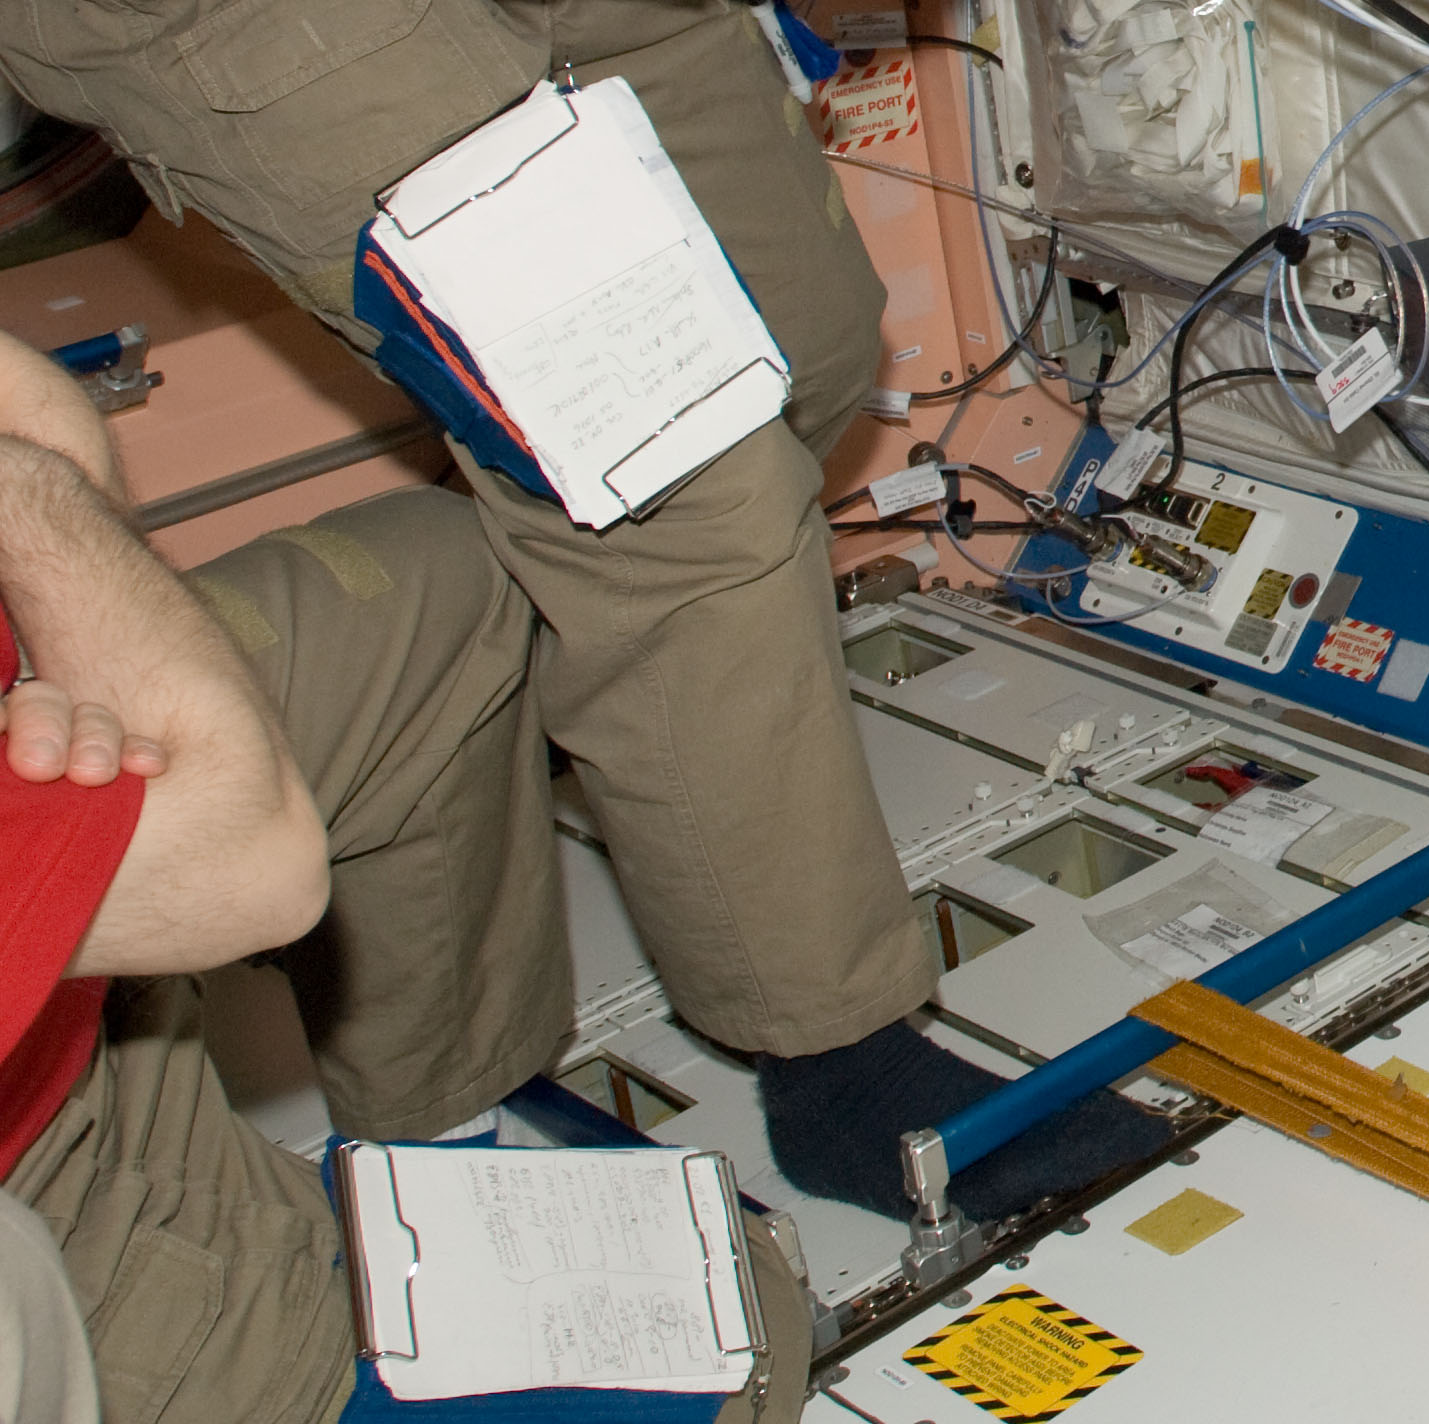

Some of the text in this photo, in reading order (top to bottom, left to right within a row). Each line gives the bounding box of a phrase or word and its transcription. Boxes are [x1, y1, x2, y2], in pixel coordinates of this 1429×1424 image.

[831, 74, 902, 99] EMERGENCY USE
[835, 95, 903, 120] FIRE PORT
[1211, 473, 1225, 491] 2
[1333, 639, 1351, 652] FIRE
[1352, 646, 1376, 658] PORT
[1029, 1315, 1085, 1351] WARNING
